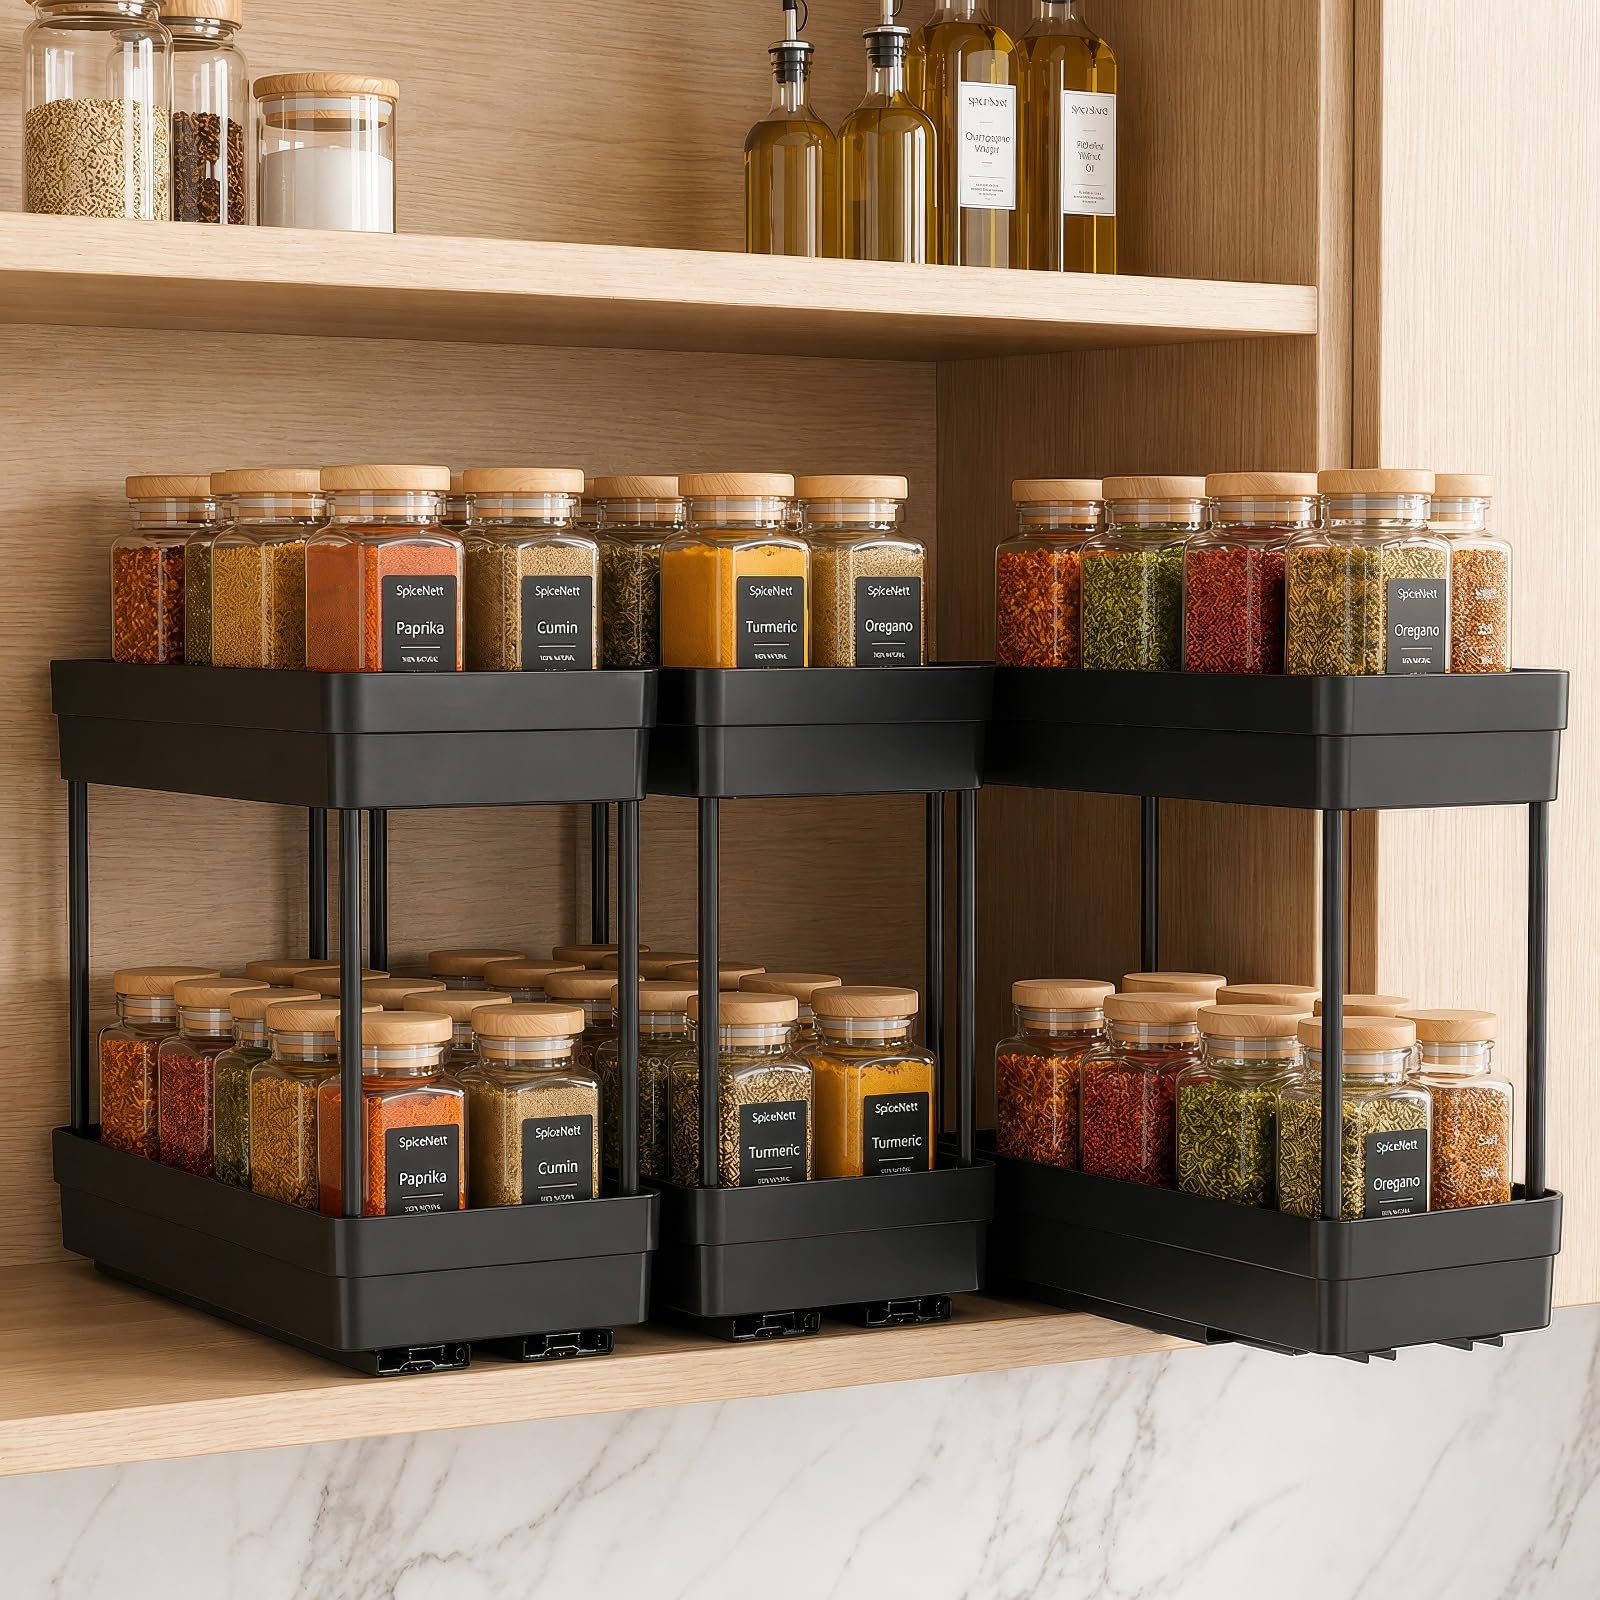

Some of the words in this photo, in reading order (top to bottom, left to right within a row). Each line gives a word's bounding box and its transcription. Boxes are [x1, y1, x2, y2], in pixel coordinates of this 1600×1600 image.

[396, 621, 445, 638] Paprika
[537, 620, 578, 634] Cumin
[746, 620, 797, 634] Turmeric
[865, 619, 913, 636] Oregano
[1394, 623, 1440, 640] Oregano
[872, 1134, 922, 1150] Turmeric
[748, 1143, 800, 1159] Turmeric
[538, 1160, 578, 1175] Cumin
[399, 1169, 447, 1187] Paprika
[1373, 1176, 1421, 1193] Oregano
